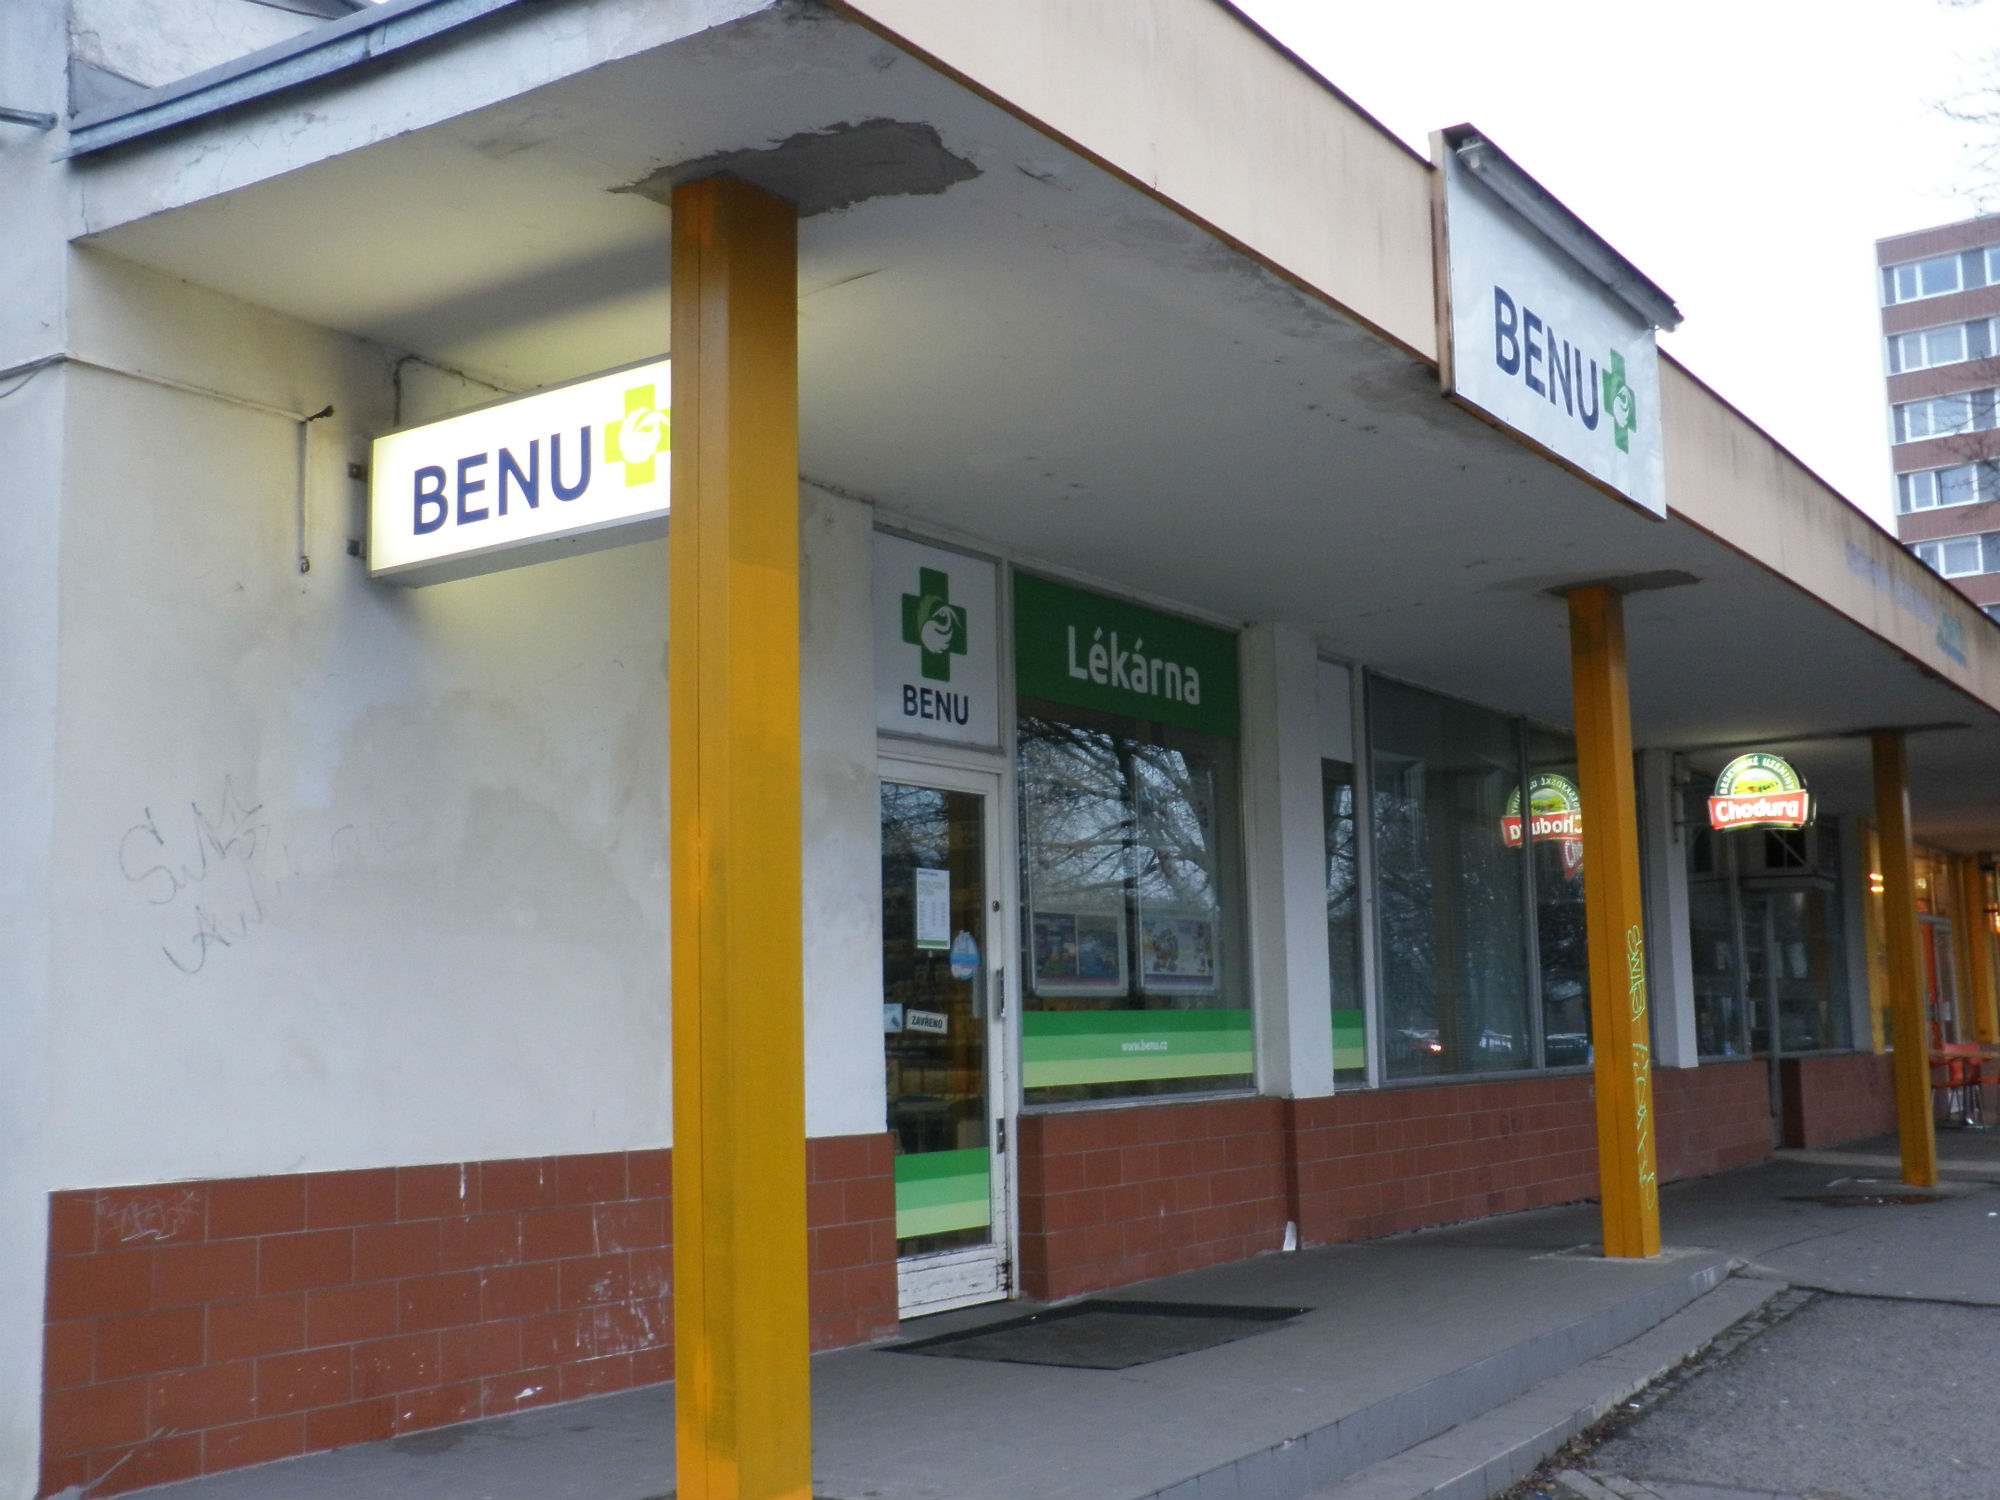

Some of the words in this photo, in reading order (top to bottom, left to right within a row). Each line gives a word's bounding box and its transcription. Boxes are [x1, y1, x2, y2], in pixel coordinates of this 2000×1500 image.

[1494, 285, 1600, 431] BENU
[413, 425, 592, 536] BENU
[1067, 625, 1201, 706] Lékárna
[903, 684, 970, 726] BENU
[1719, 755, 1759, 795] BESKKÉ
[1714, 797, 1800, 823] Chodura
[911, 1014, 943, 1029] ZAVŘENO
[1121, 1039, 1168, 1052] www.benu.cz
